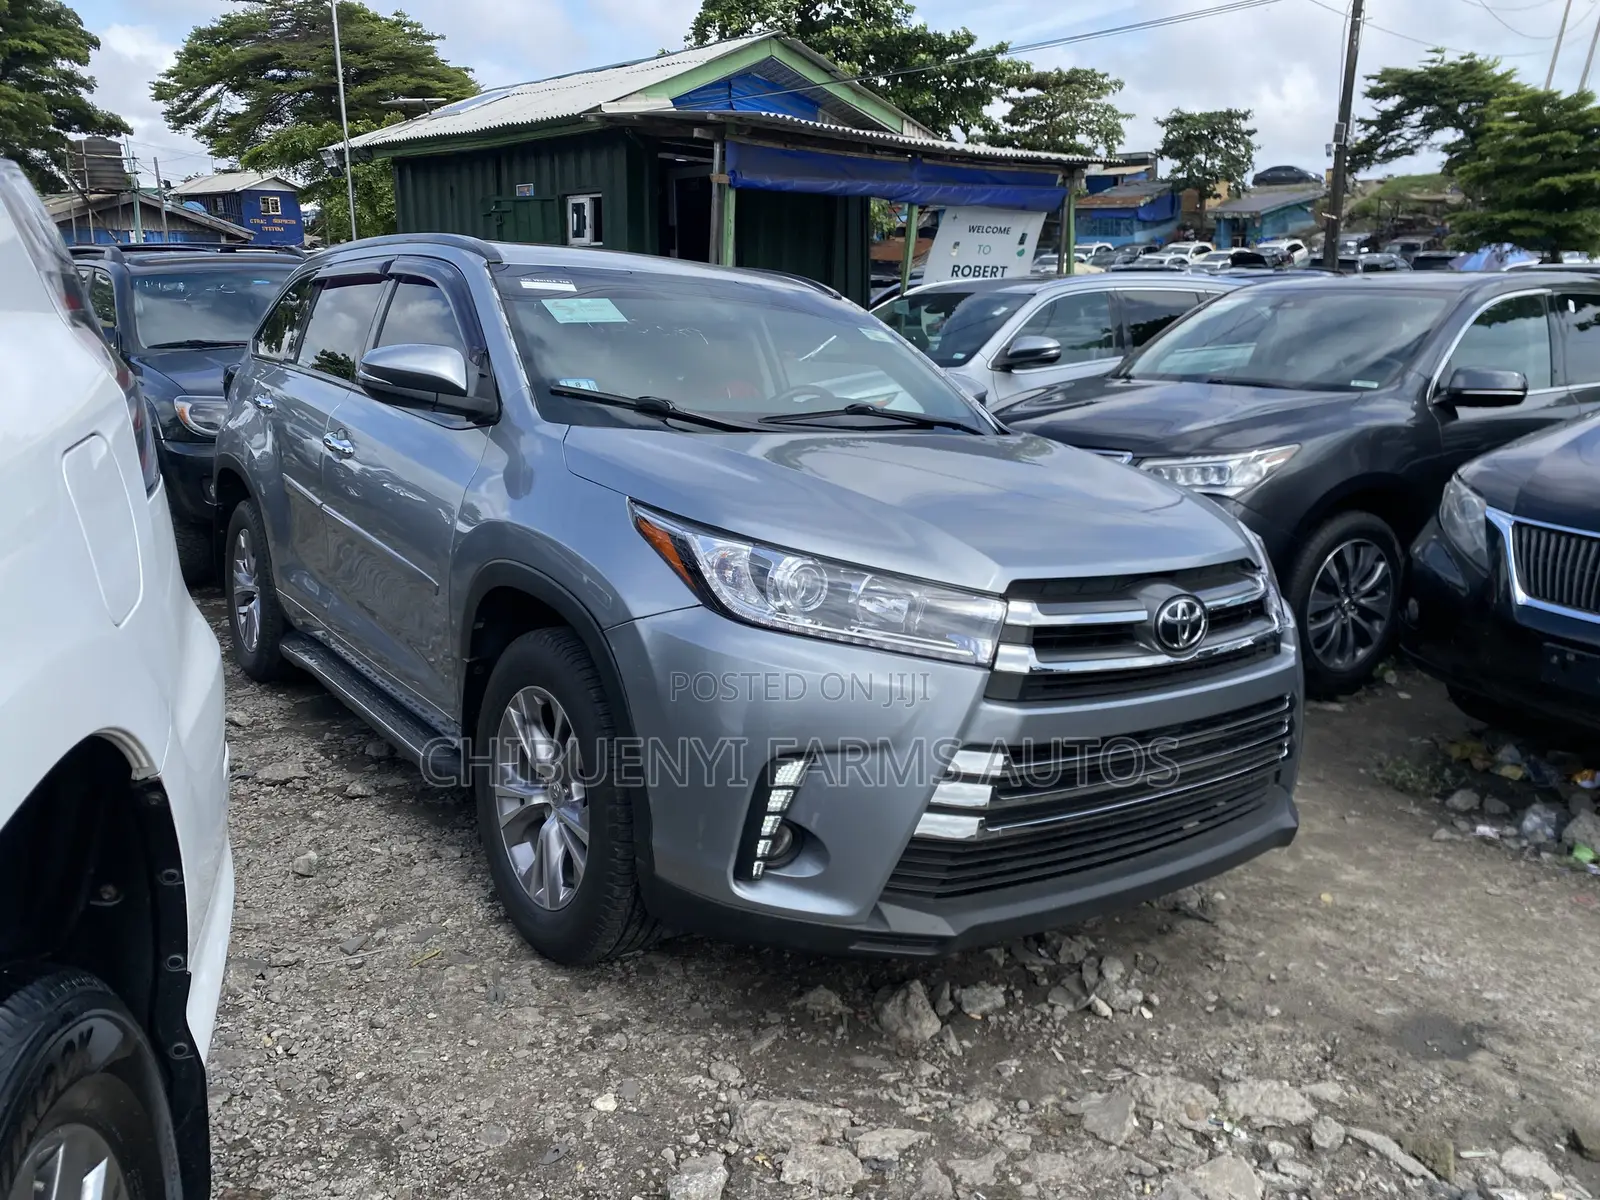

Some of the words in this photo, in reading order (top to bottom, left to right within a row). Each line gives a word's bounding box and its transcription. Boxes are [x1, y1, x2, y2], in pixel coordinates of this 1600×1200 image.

[968, 224, 1012, 235] WELCOME
[977, 244, 992, 256] TO
[950, 264, 1008, 278] ROBERT
